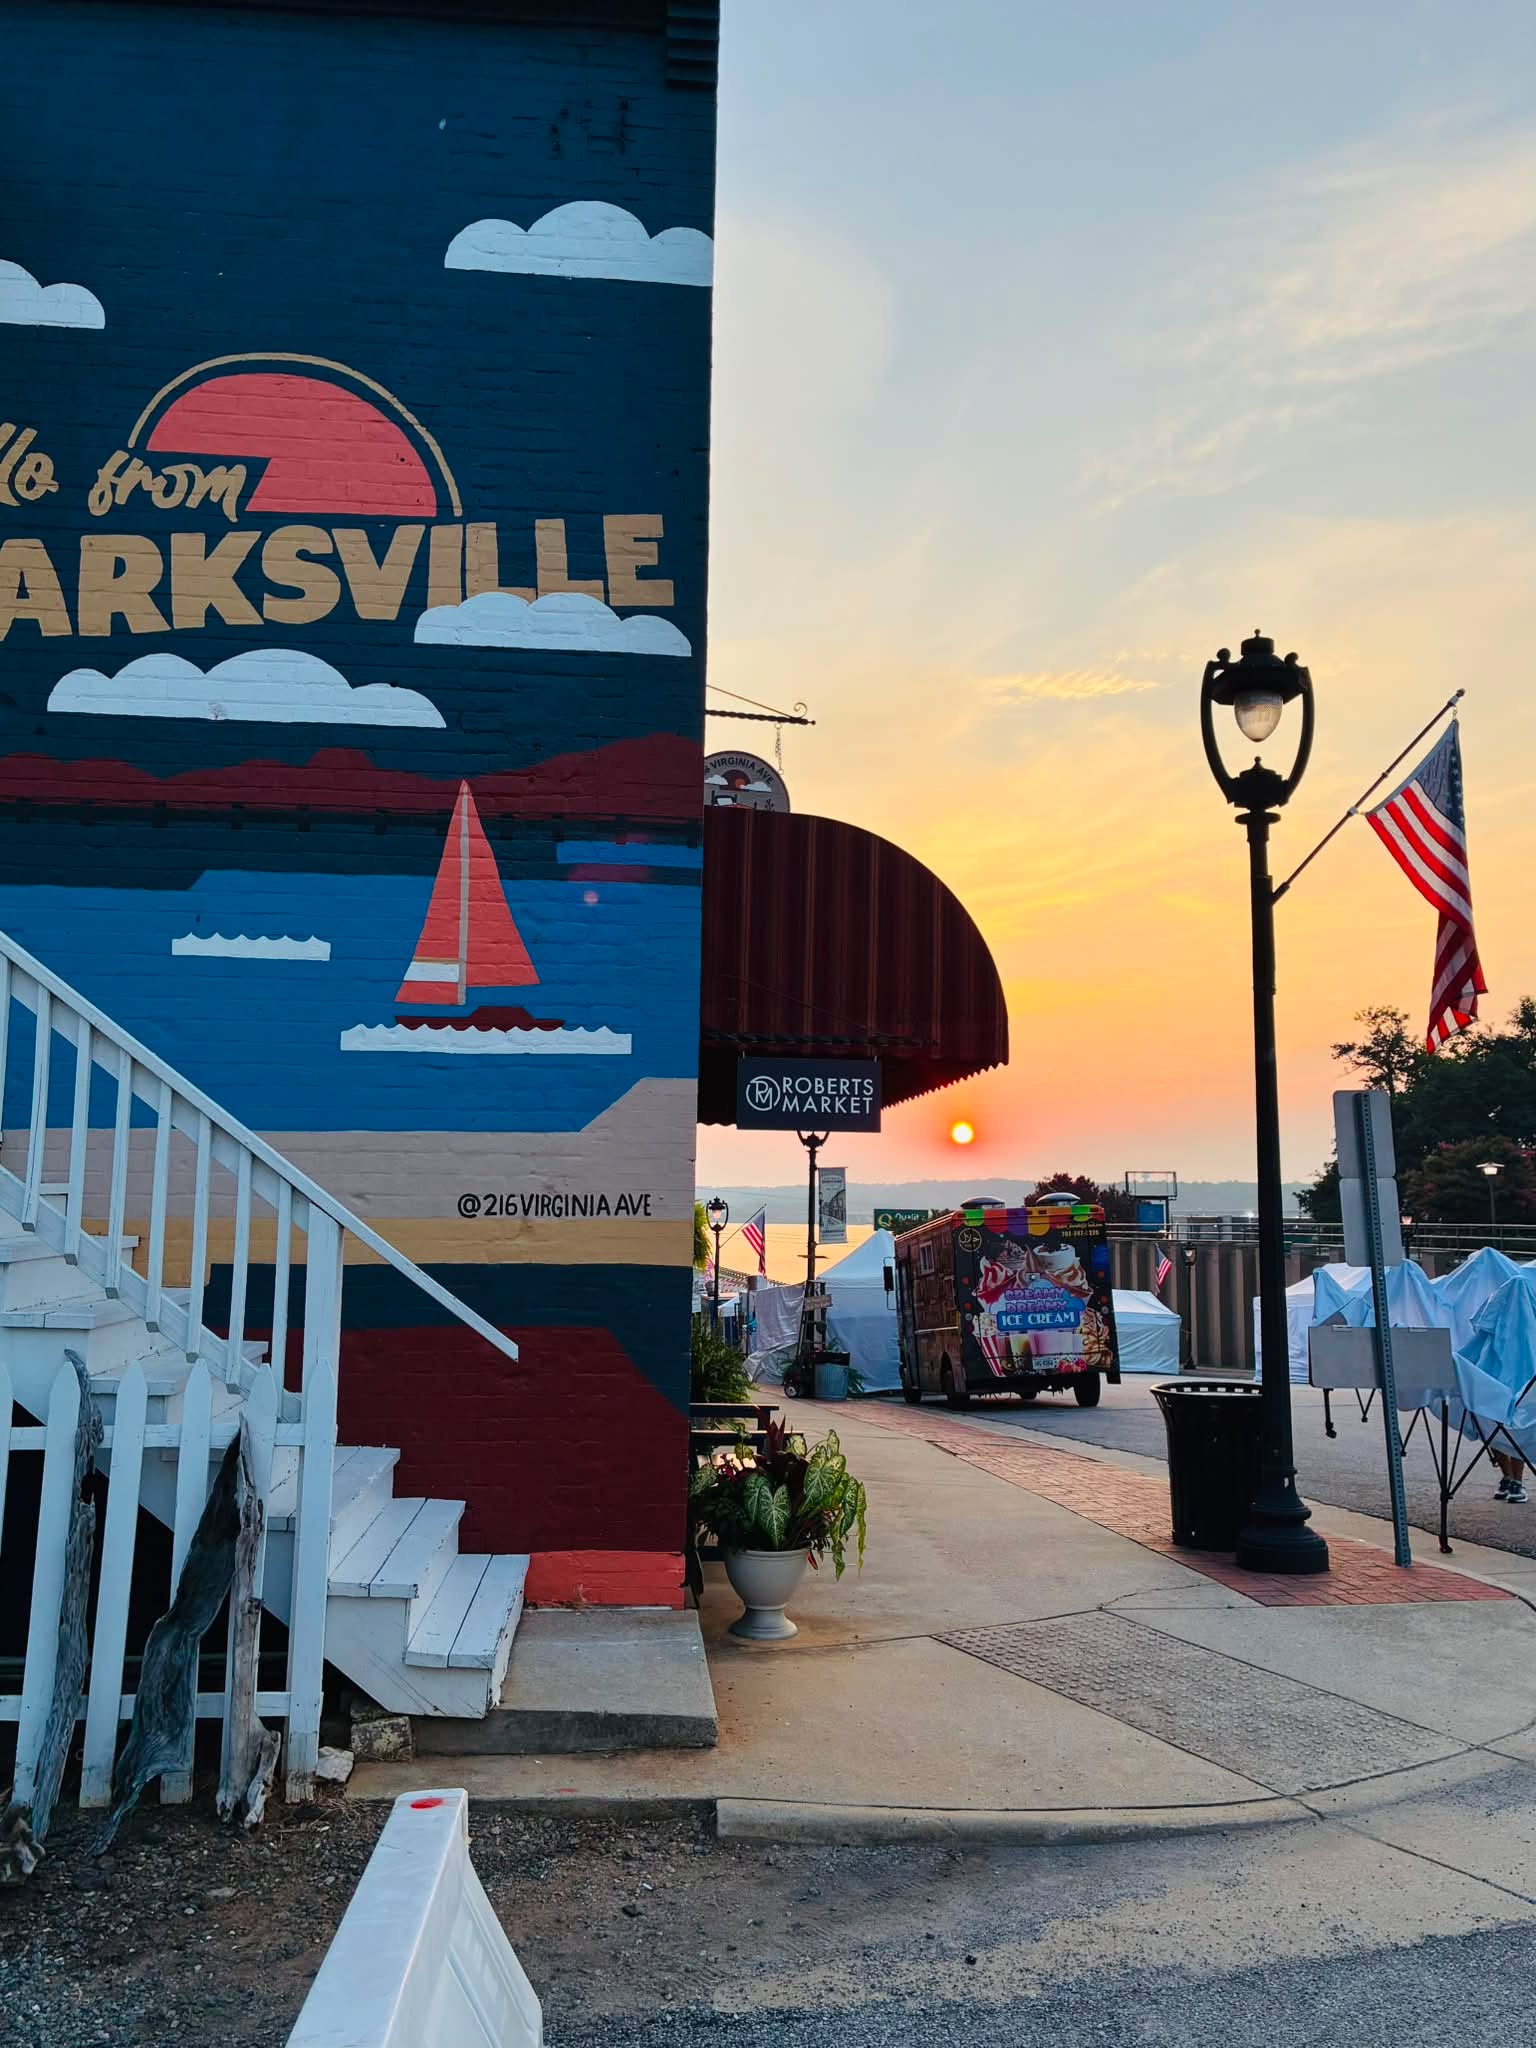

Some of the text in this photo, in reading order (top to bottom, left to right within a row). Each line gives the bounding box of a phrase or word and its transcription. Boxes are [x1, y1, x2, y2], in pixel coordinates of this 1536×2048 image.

[88, 450, 247, 523] from
[0, 514, 675, 642] ARKSVILLE
[710, 756, 756, 771] VIRGINIA
[756, 767, 775, 785] AVE
[782, 1076, 874, 1096] ROBERTS
[782, 1095, 873, 1114] MARKET
[520, 1192, 611, 1218] VIRGINIA
[614, 1192, 652, 1217] AVE
[1001, 1311, 1075, 1326] ICE CREAM
